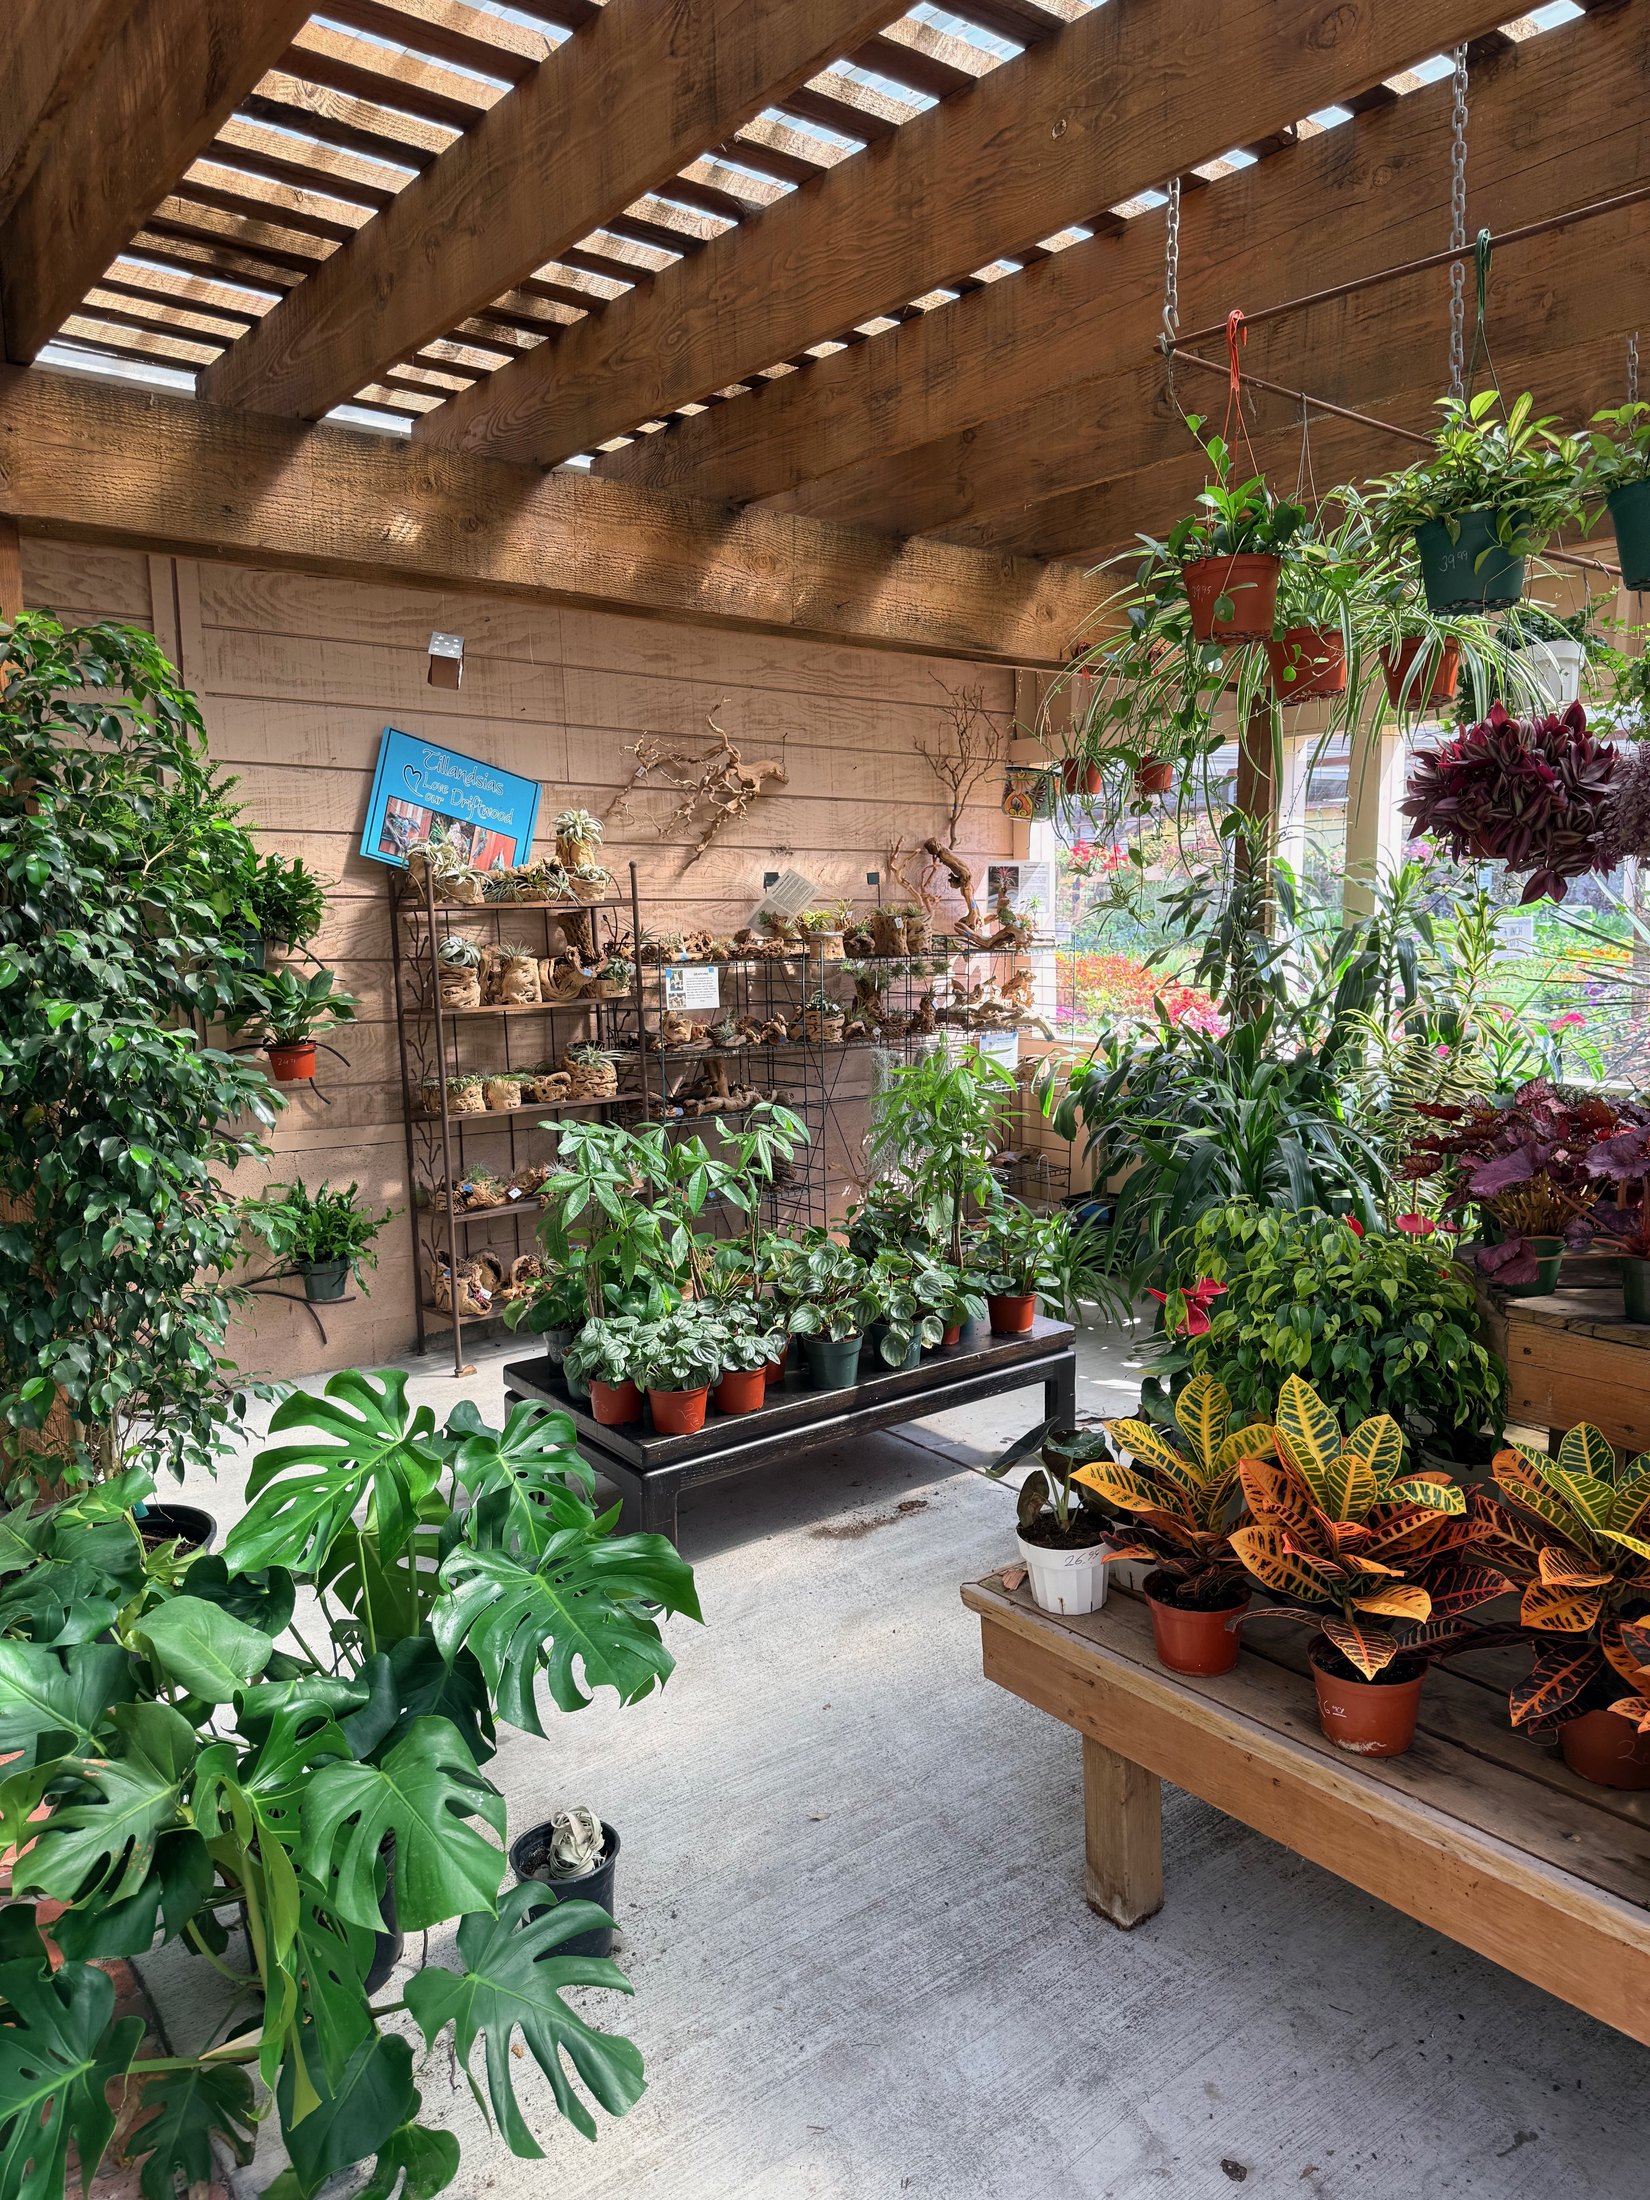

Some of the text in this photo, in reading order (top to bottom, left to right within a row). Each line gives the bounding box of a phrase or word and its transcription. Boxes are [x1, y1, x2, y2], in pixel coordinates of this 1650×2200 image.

[422, 748, 504, 796] Tillandsias
[423, 771, 449, 794] Love
[425, 787, 515, 825] our Driftwood
